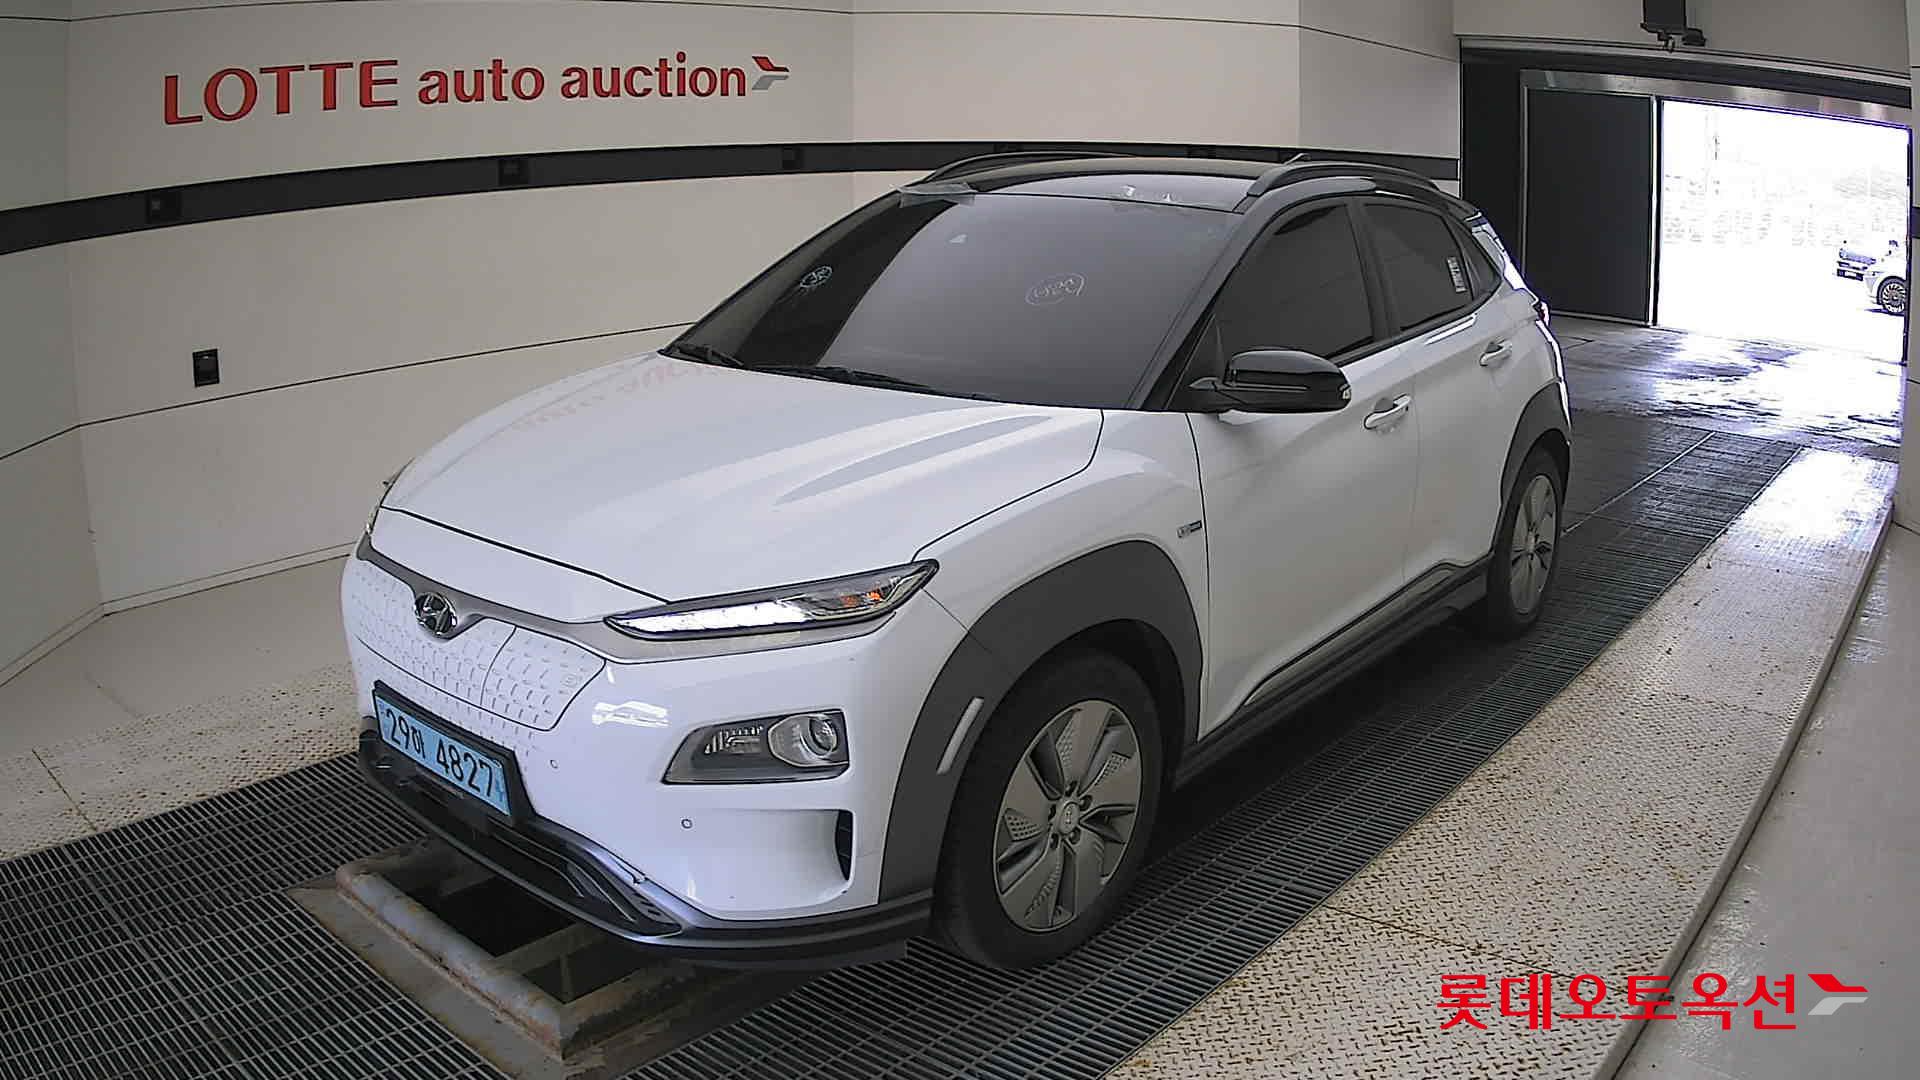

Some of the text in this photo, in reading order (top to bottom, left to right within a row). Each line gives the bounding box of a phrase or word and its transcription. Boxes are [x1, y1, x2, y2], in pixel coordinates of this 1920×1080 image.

[163, 51, 748, 126] LOTTE auto auction
[436, 739, 494, 797] 4827
